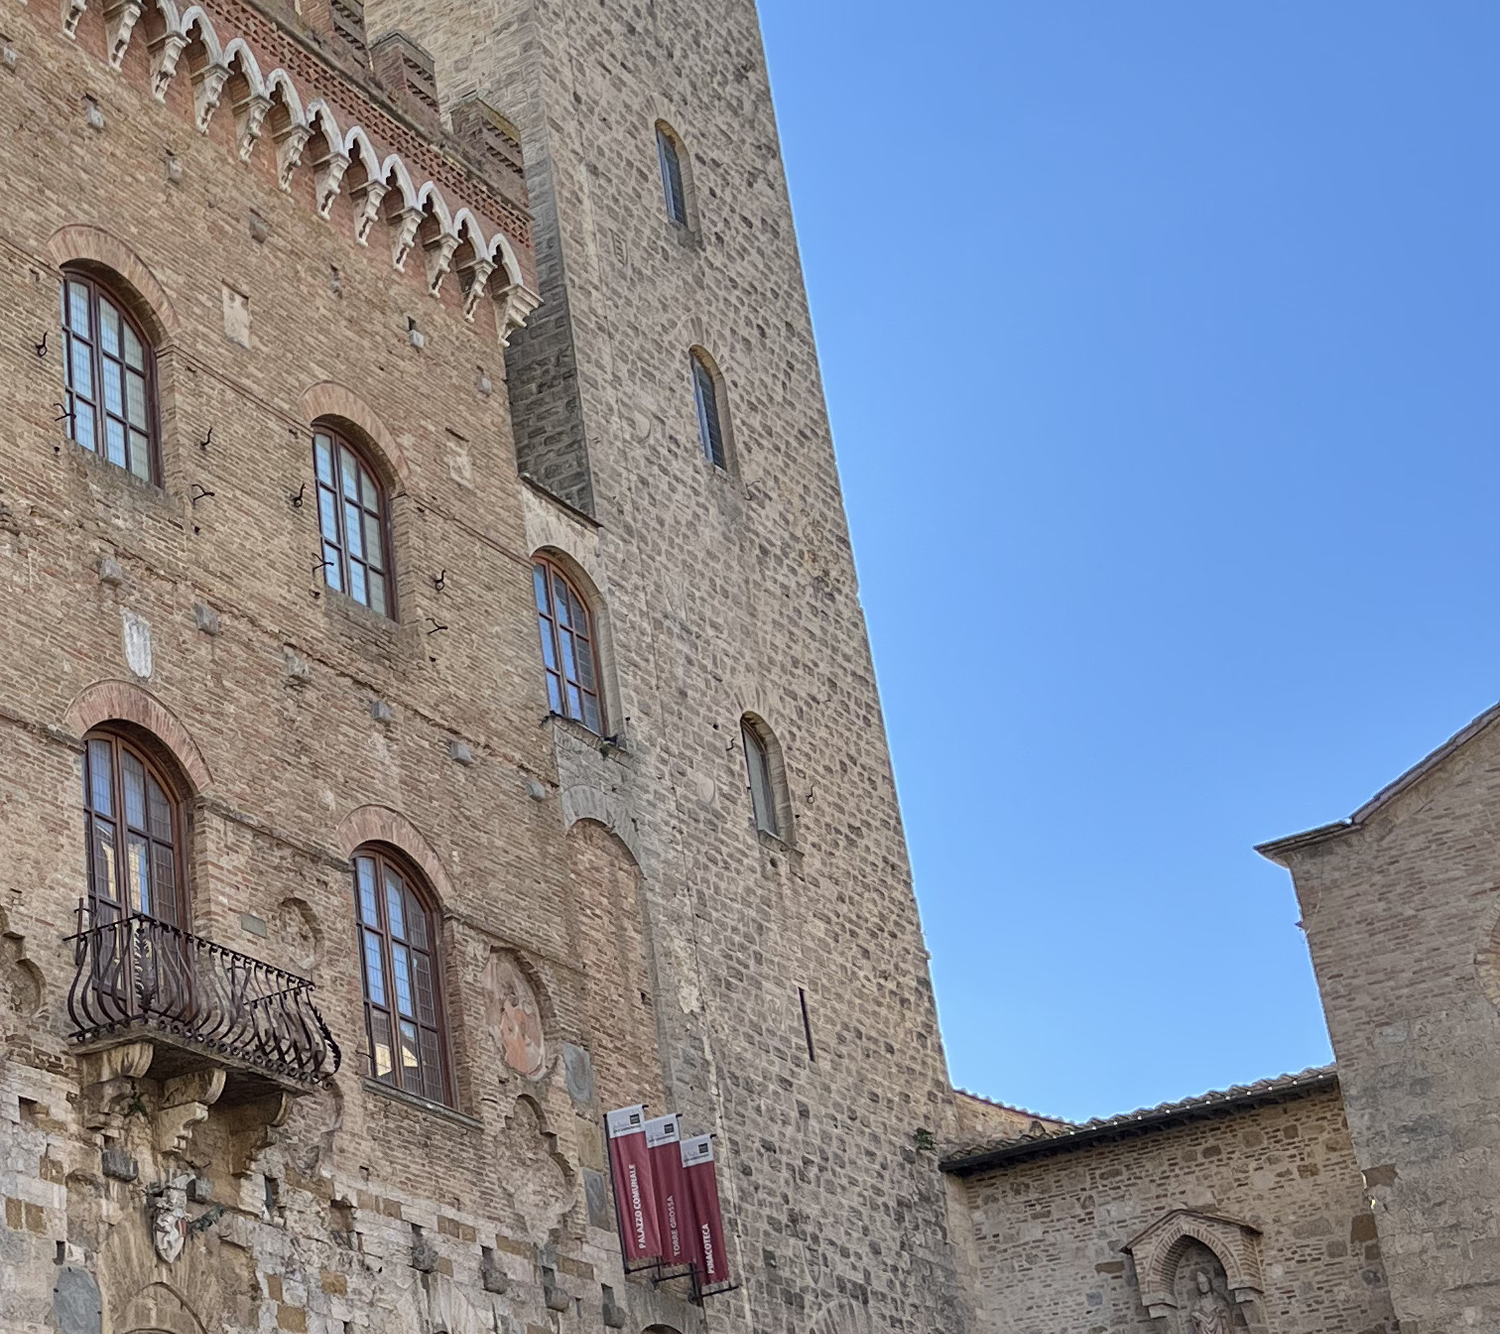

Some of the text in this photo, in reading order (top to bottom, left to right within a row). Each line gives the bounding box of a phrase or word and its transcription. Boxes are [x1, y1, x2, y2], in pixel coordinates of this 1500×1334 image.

[629, 1165, 646, 1249] PALAZZO COMUNALE
[667, 1195, 680, 1256] TORRE GROSSA
[702, 1223, 715, 1274] PINACOTECA
